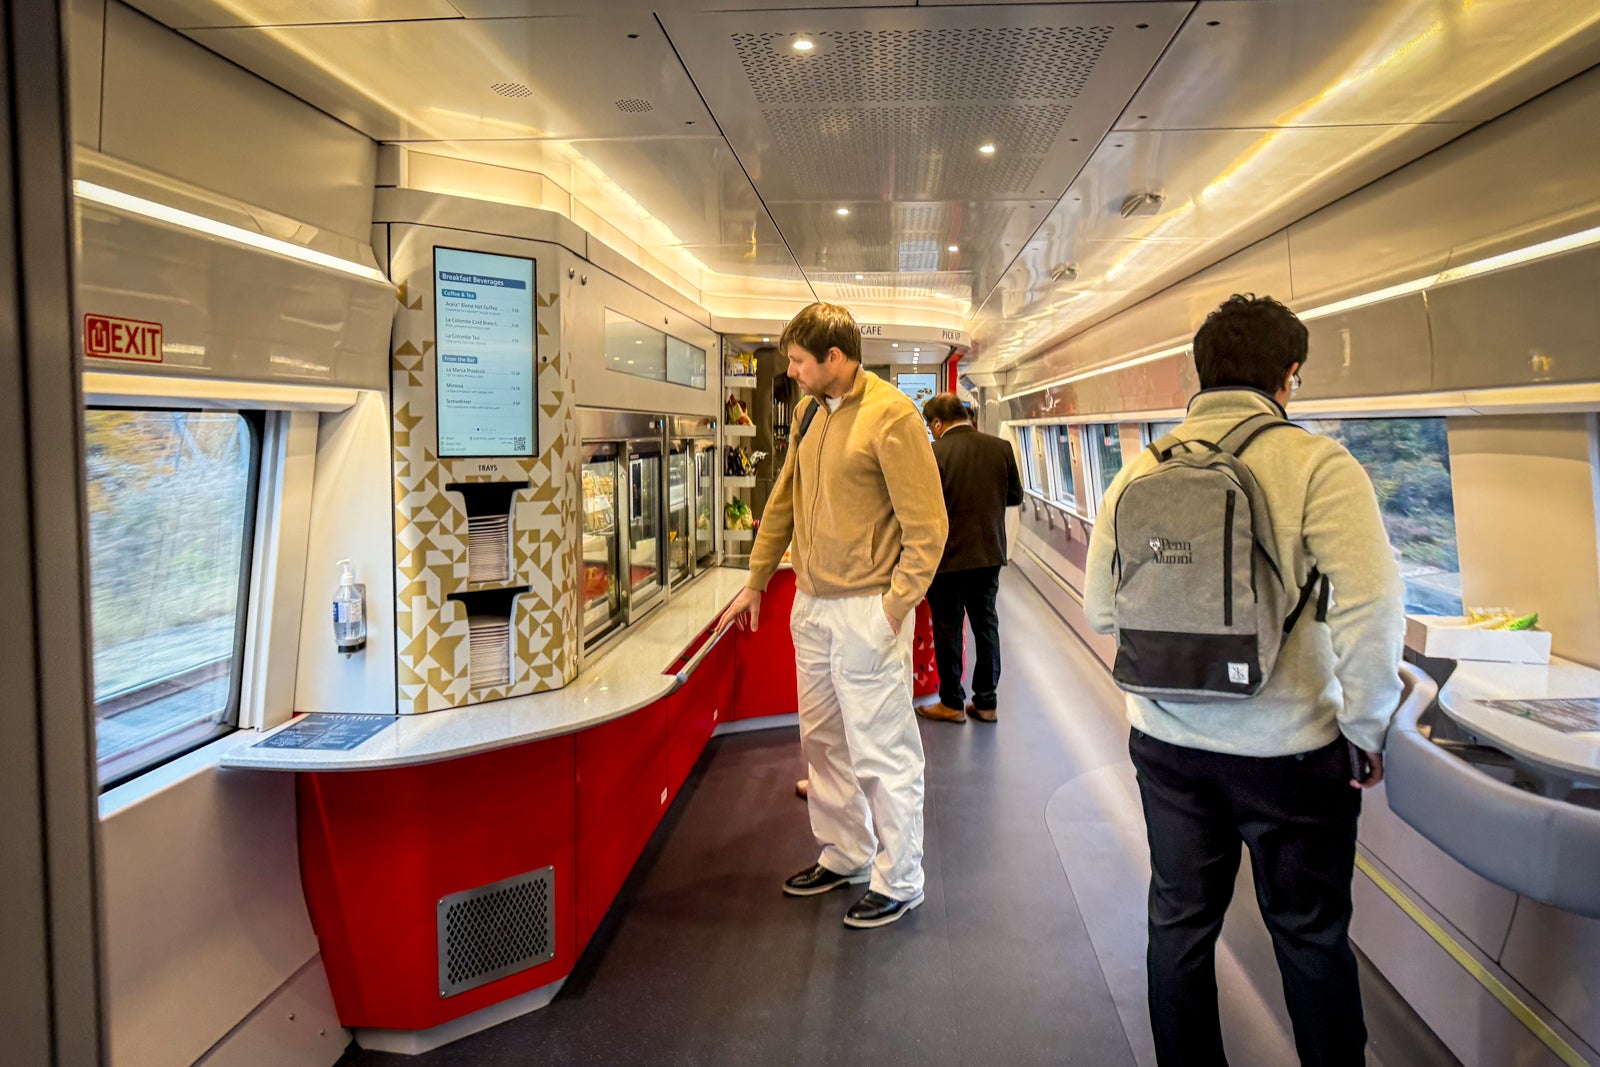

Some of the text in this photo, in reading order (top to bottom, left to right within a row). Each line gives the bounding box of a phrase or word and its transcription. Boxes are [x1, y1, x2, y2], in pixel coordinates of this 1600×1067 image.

[442, 272, 504, 287] Breakfast Beverages
[452, 332, 471, 340] Colombe
[860, 325, 882, 336] CAFE
[942, 330, 961, 341] PICK UP
[112, 323, 160, 356] EXIT
[478, 464, 498, 472] TRAYS
[1161, 538, 1191, 550] Penn
[1154, 551, 1192, 563] Alumni
